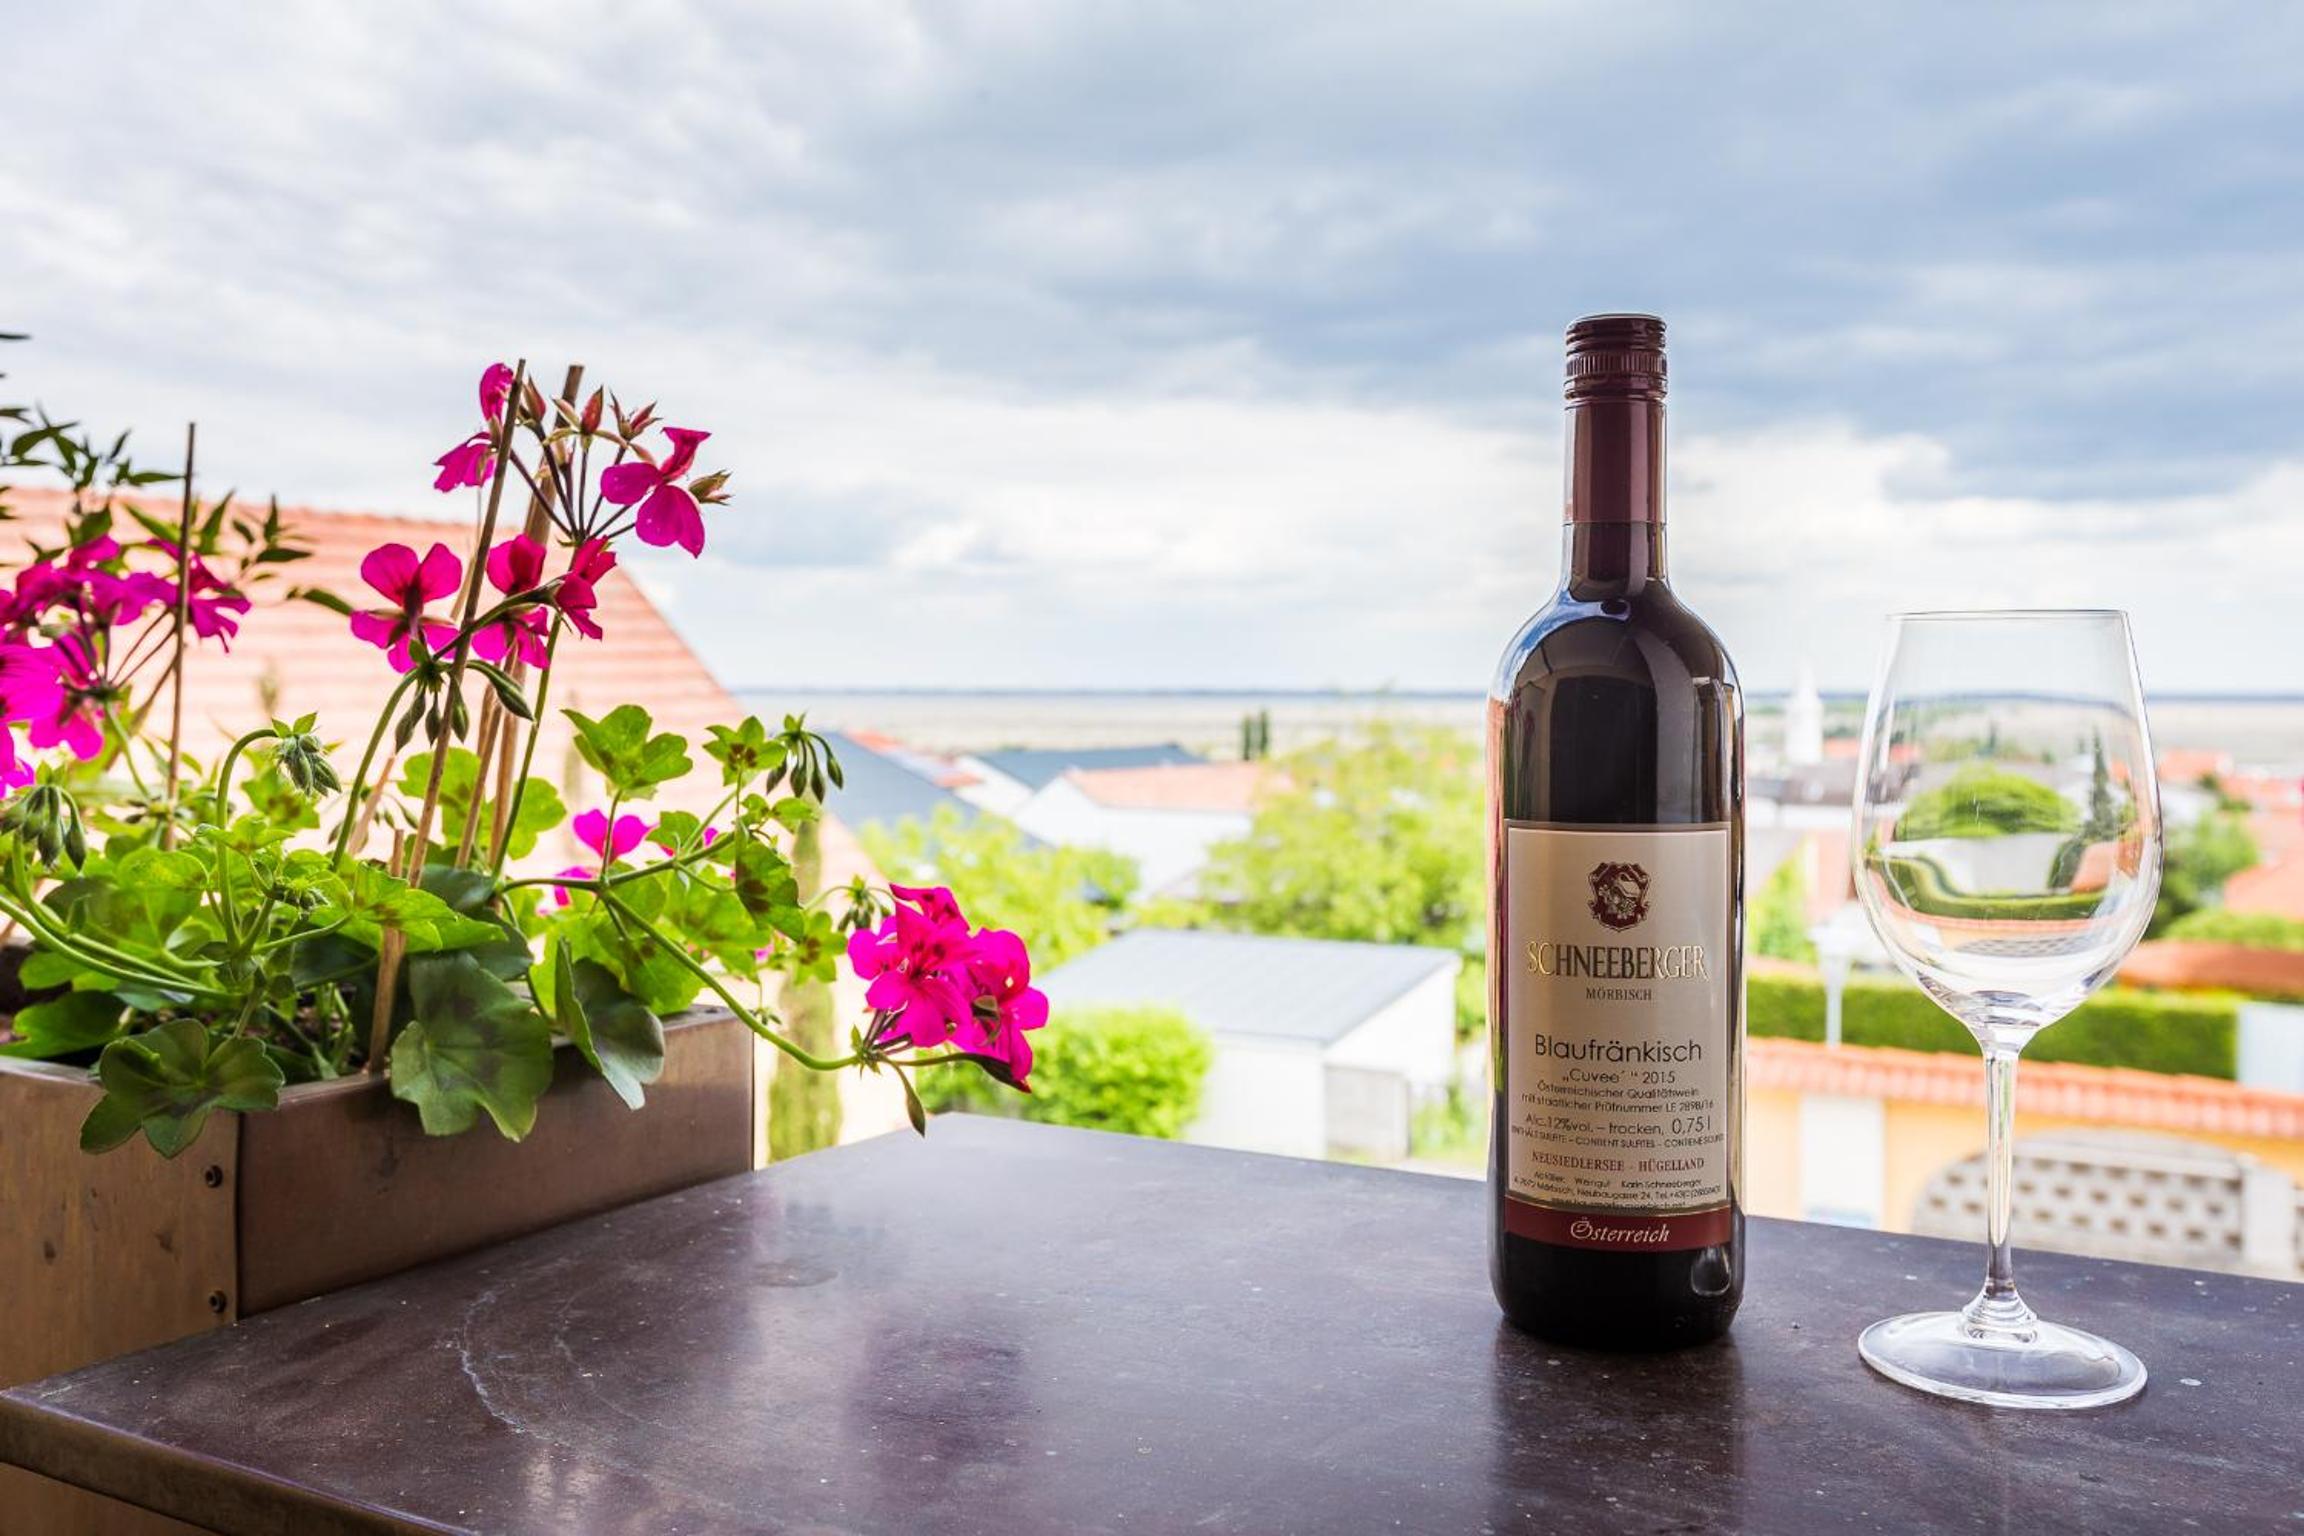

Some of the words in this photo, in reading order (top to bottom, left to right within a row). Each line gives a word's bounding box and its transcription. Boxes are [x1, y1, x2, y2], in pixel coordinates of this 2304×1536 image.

[1527, 941, 1709, 981] SCHNEEBERGER
[1586, 986, 1652, 1000] MÖRBISCH
[1535, 1034, 1702, 1062] Blaufränkisch
[1642, 1071, 1675, 1084] 2015
[1532, 1151, 1624, 1171] NEUSIEDLERSEE
[1639, 1158, 1704, 1172] HÜGELLAND
[1570, 1216, 1671, 1243] Österreich
